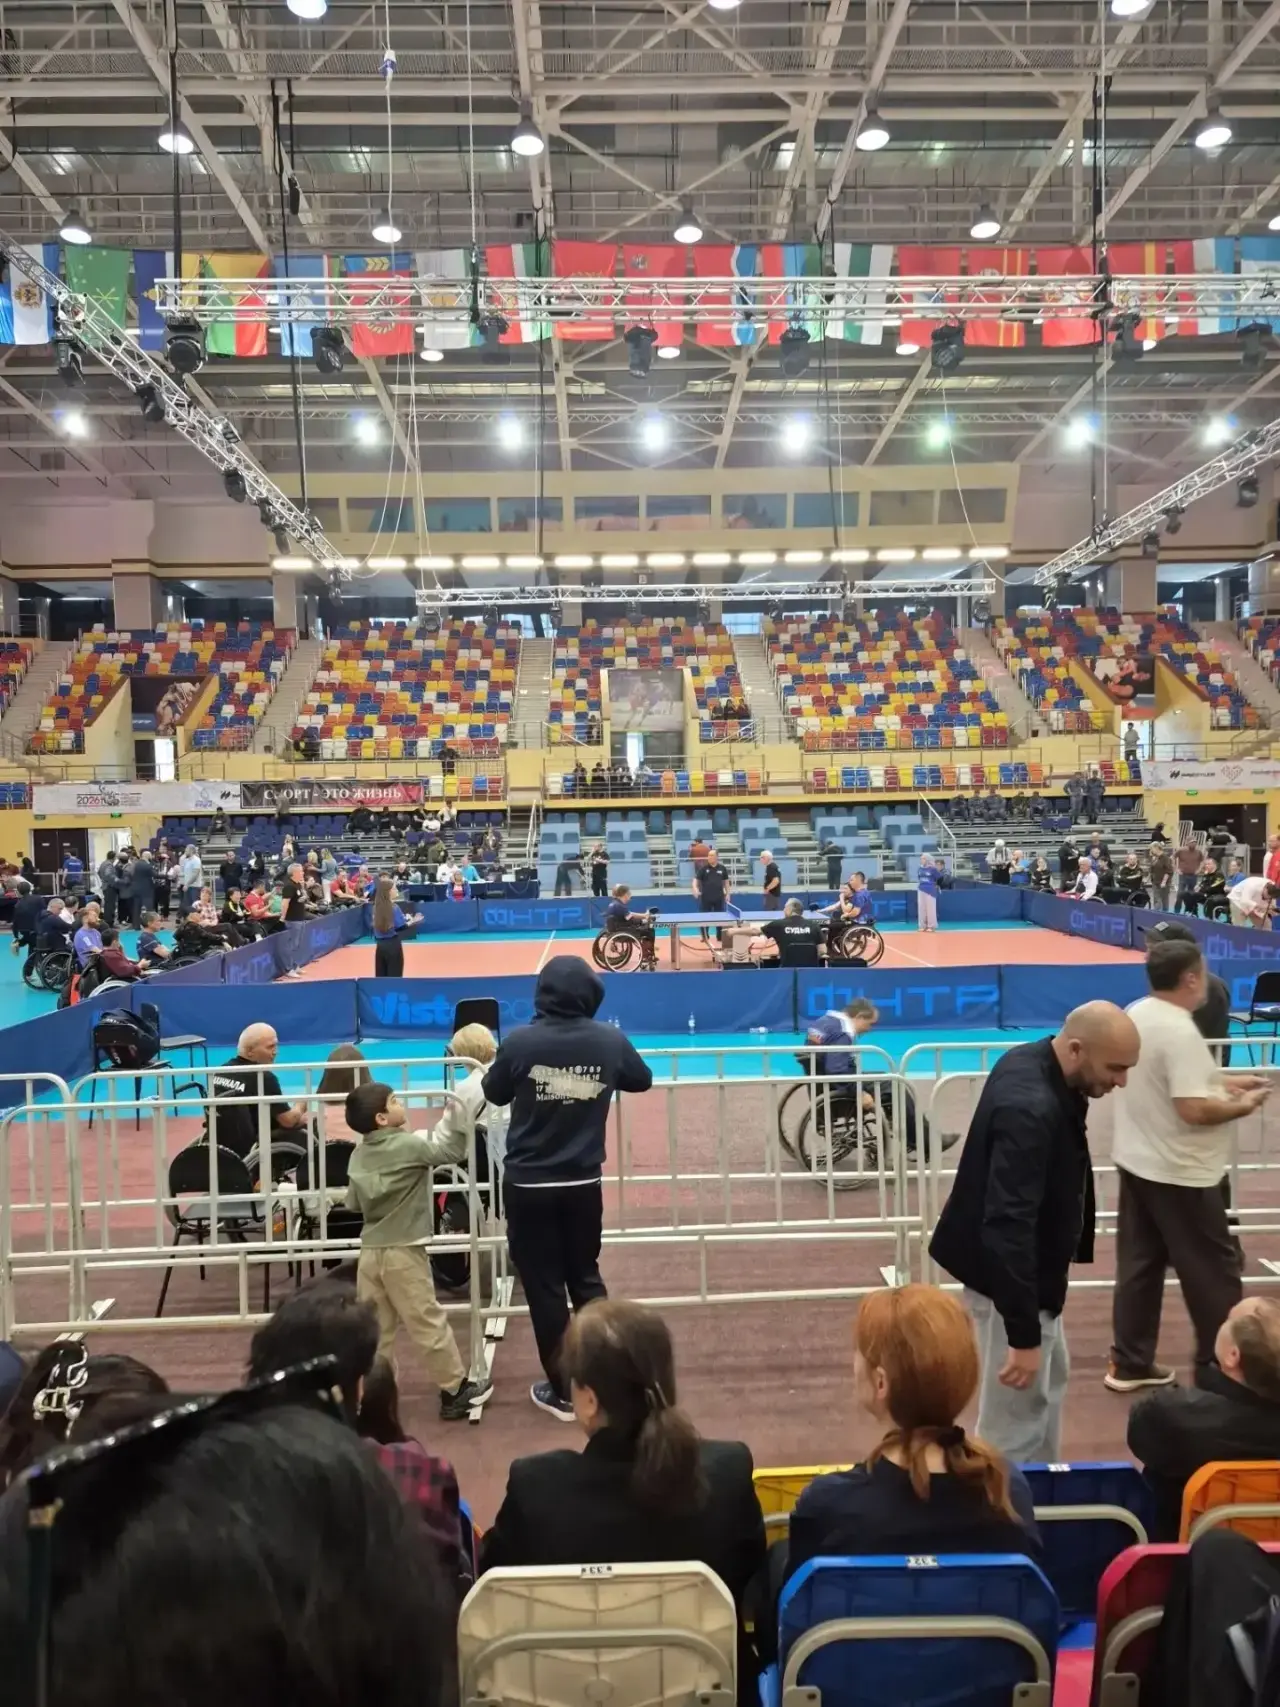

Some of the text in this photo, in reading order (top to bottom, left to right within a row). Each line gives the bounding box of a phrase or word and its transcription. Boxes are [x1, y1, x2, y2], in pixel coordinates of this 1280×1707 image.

[264, 788, 311, 800] СОРТ
[323, 787, 349, 800] ЭТО
[352, 786, 402, 799] ЖИЗНЬ
[77, 796, 100, 805] 2026
[784, 926, 811, 935] СУДЬЯ
[371, 991, 456, 1025] Vist
